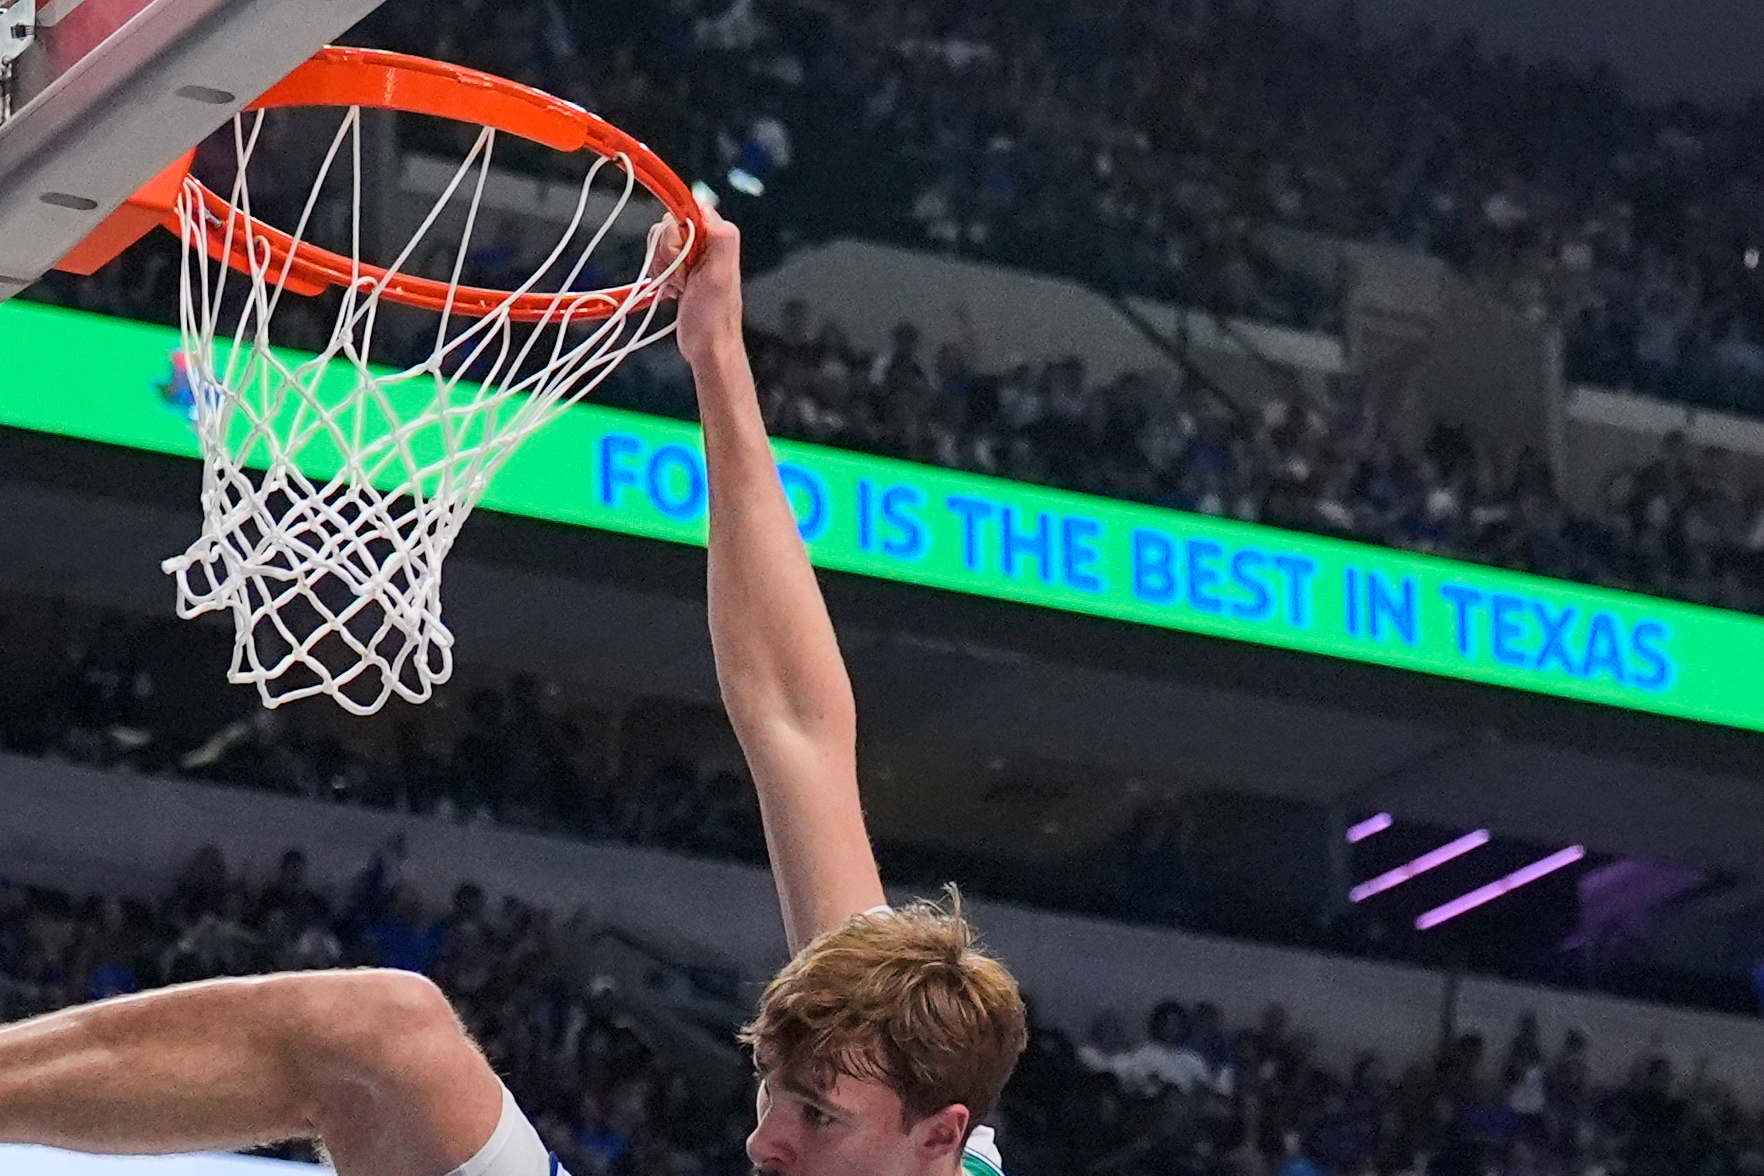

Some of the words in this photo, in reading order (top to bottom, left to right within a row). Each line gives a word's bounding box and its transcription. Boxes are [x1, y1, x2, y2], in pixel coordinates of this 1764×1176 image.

[601, 433, 827, 541] FOD
[857, 477, 928, 561] IS
[946, 495, 1103, 592] THE
[1131, 528, 1317, 627] BEST
[1345, 566, 1419, 645] IN
[1440, 583, 1677, 692] TEXAS
